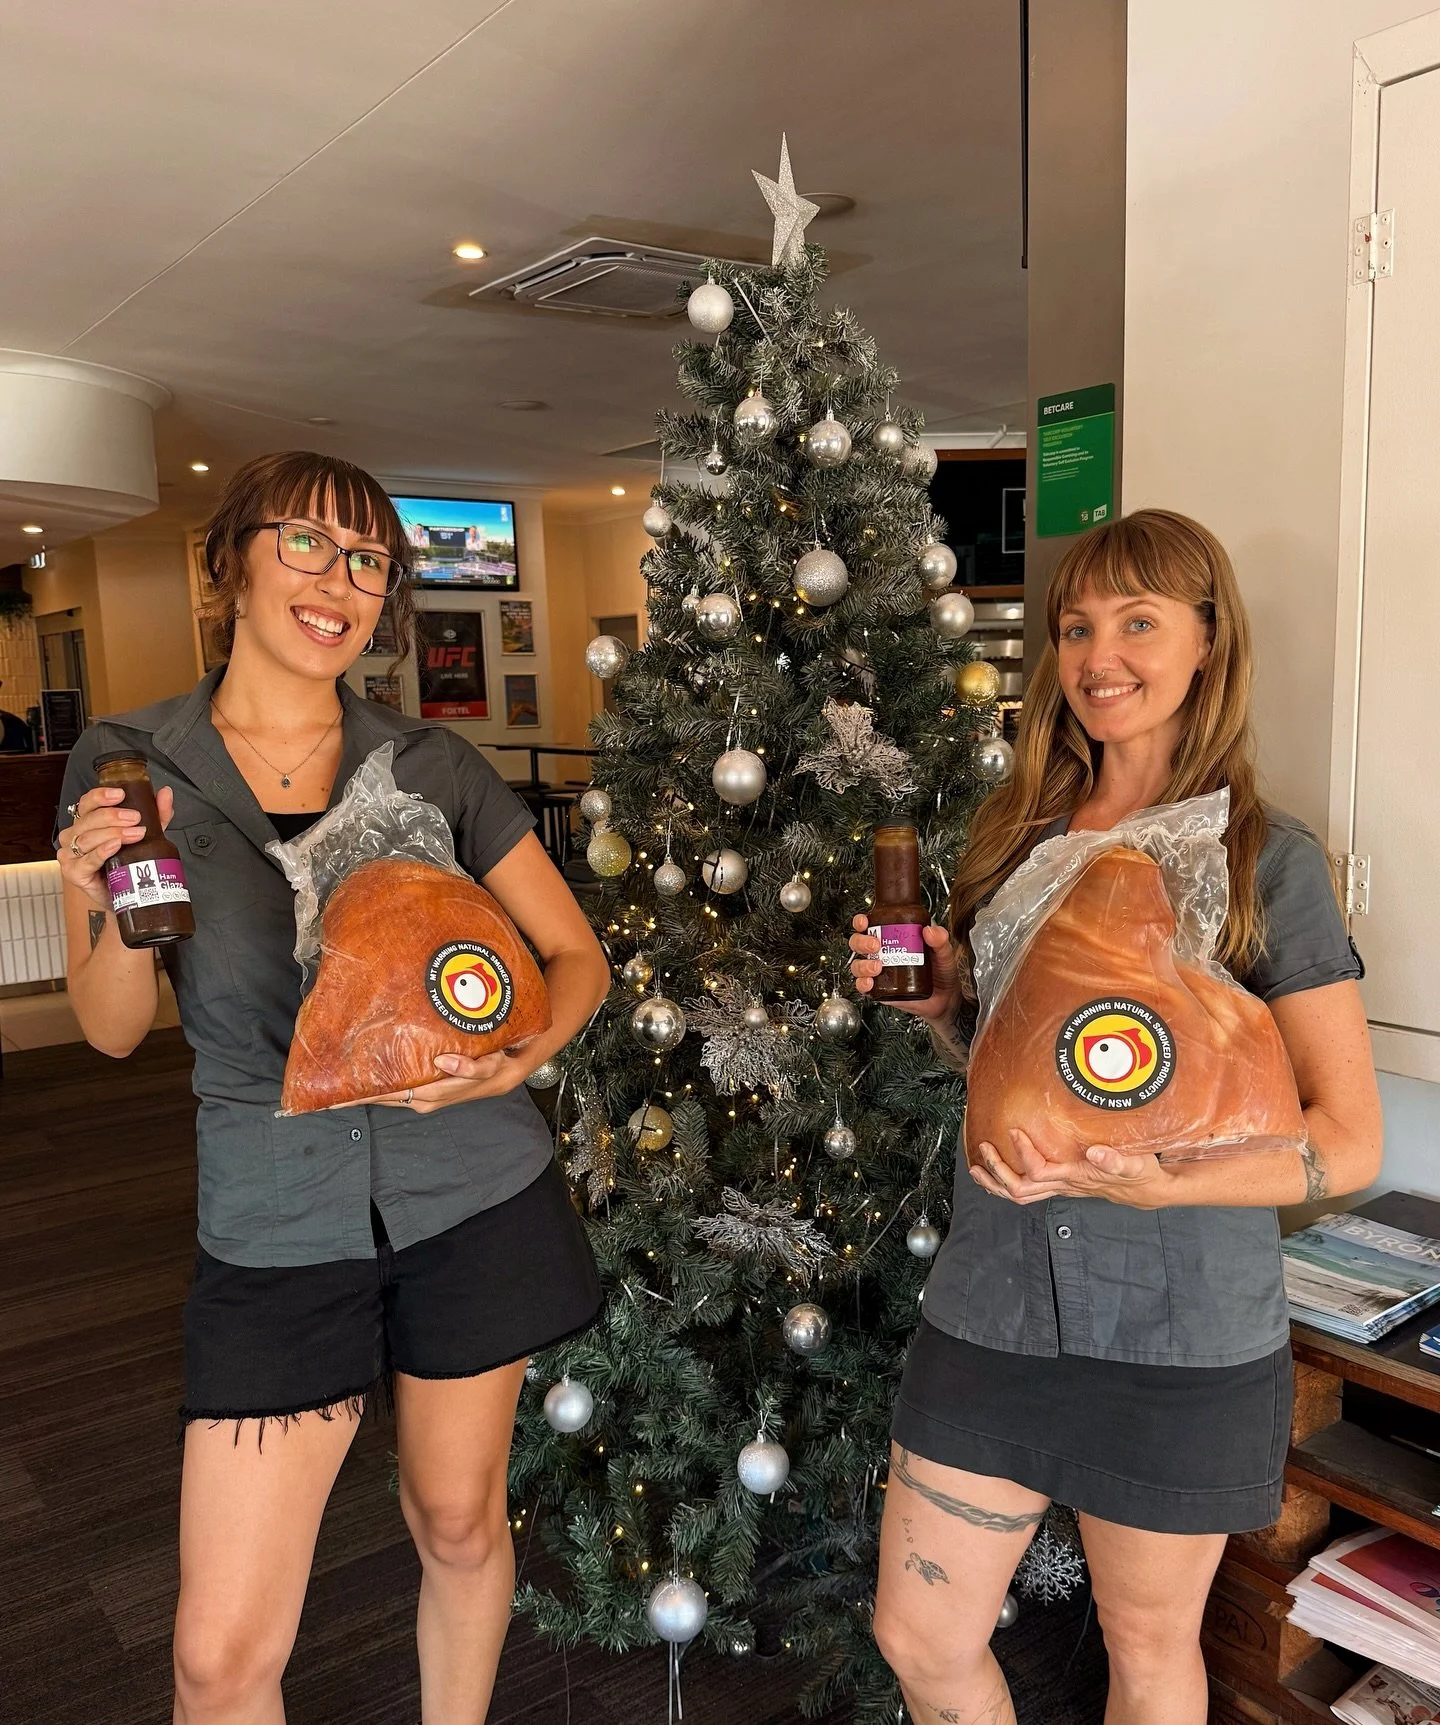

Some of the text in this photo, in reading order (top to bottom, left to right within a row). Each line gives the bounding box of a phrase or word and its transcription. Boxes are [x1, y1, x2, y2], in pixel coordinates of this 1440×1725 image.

[1043, 401, 1074, 415] BETCARE
[428, 647, 476, 667] UFC
[442, 707, 470, 715] FOXTEL
[160, 881, 184, 890] Glaze
[880, 946, 908, 954] Glaze
[430, 944, 511, 1021] MT WARNING NATURAL SMOKED PRODUCTS
[430, 988, 494, 1032] TWEED VALLEY NSW
[1064, 1002, 1171, 1100] MT WARNING NATURAL SMOKED PRODUCTS
[1059, 1048, 1132, 1108] TWEED VALLEY NSW
[1343, 1225, 1440, 1260] BYRON
